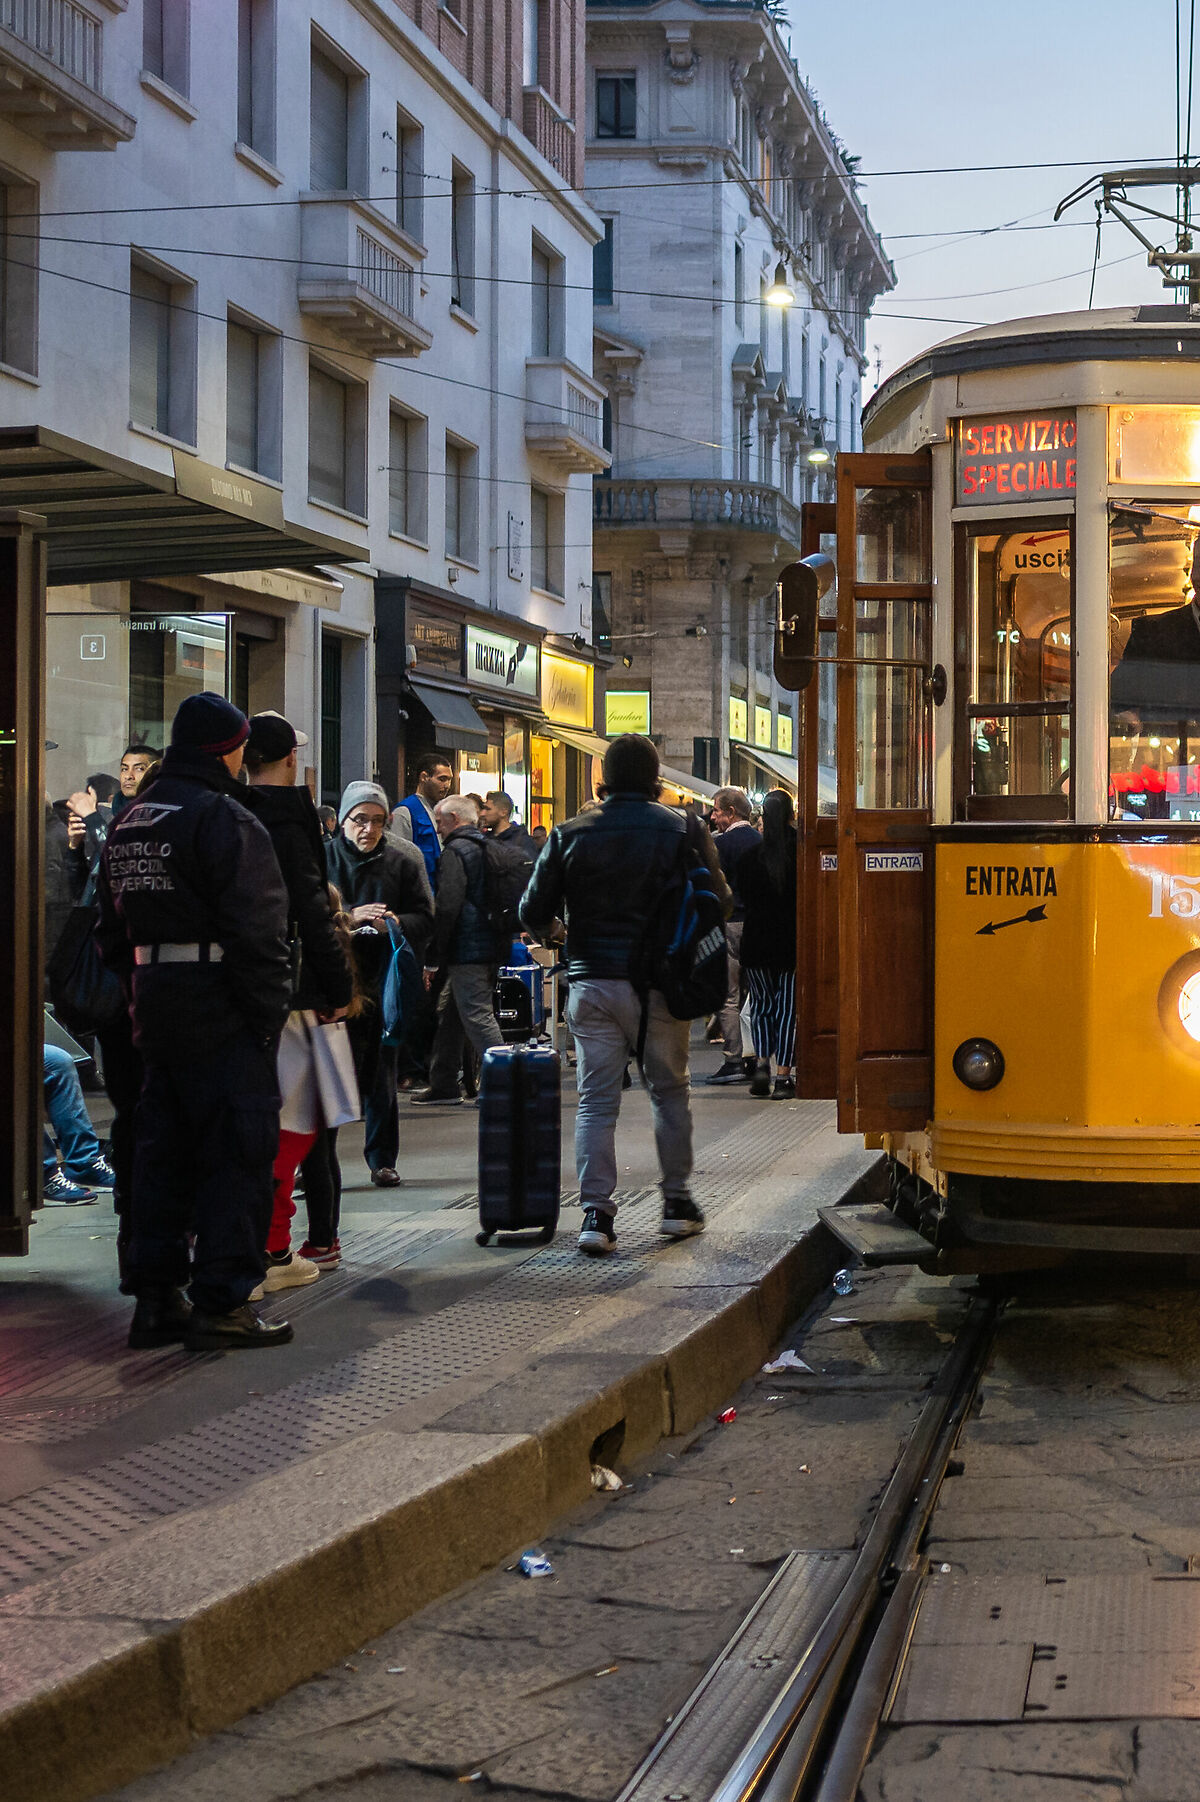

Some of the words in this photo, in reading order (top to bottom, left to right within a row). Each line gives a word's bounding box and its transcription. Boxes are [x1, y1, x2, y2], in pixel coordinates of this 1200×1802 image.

[965, 420, 1077, 456] SERVIZIO
[963, 459, 1077, 495] SPECIALE
[866, 854, 922, 869] ENTRATA
[965, 865, 1058, 897] ENTRATA
